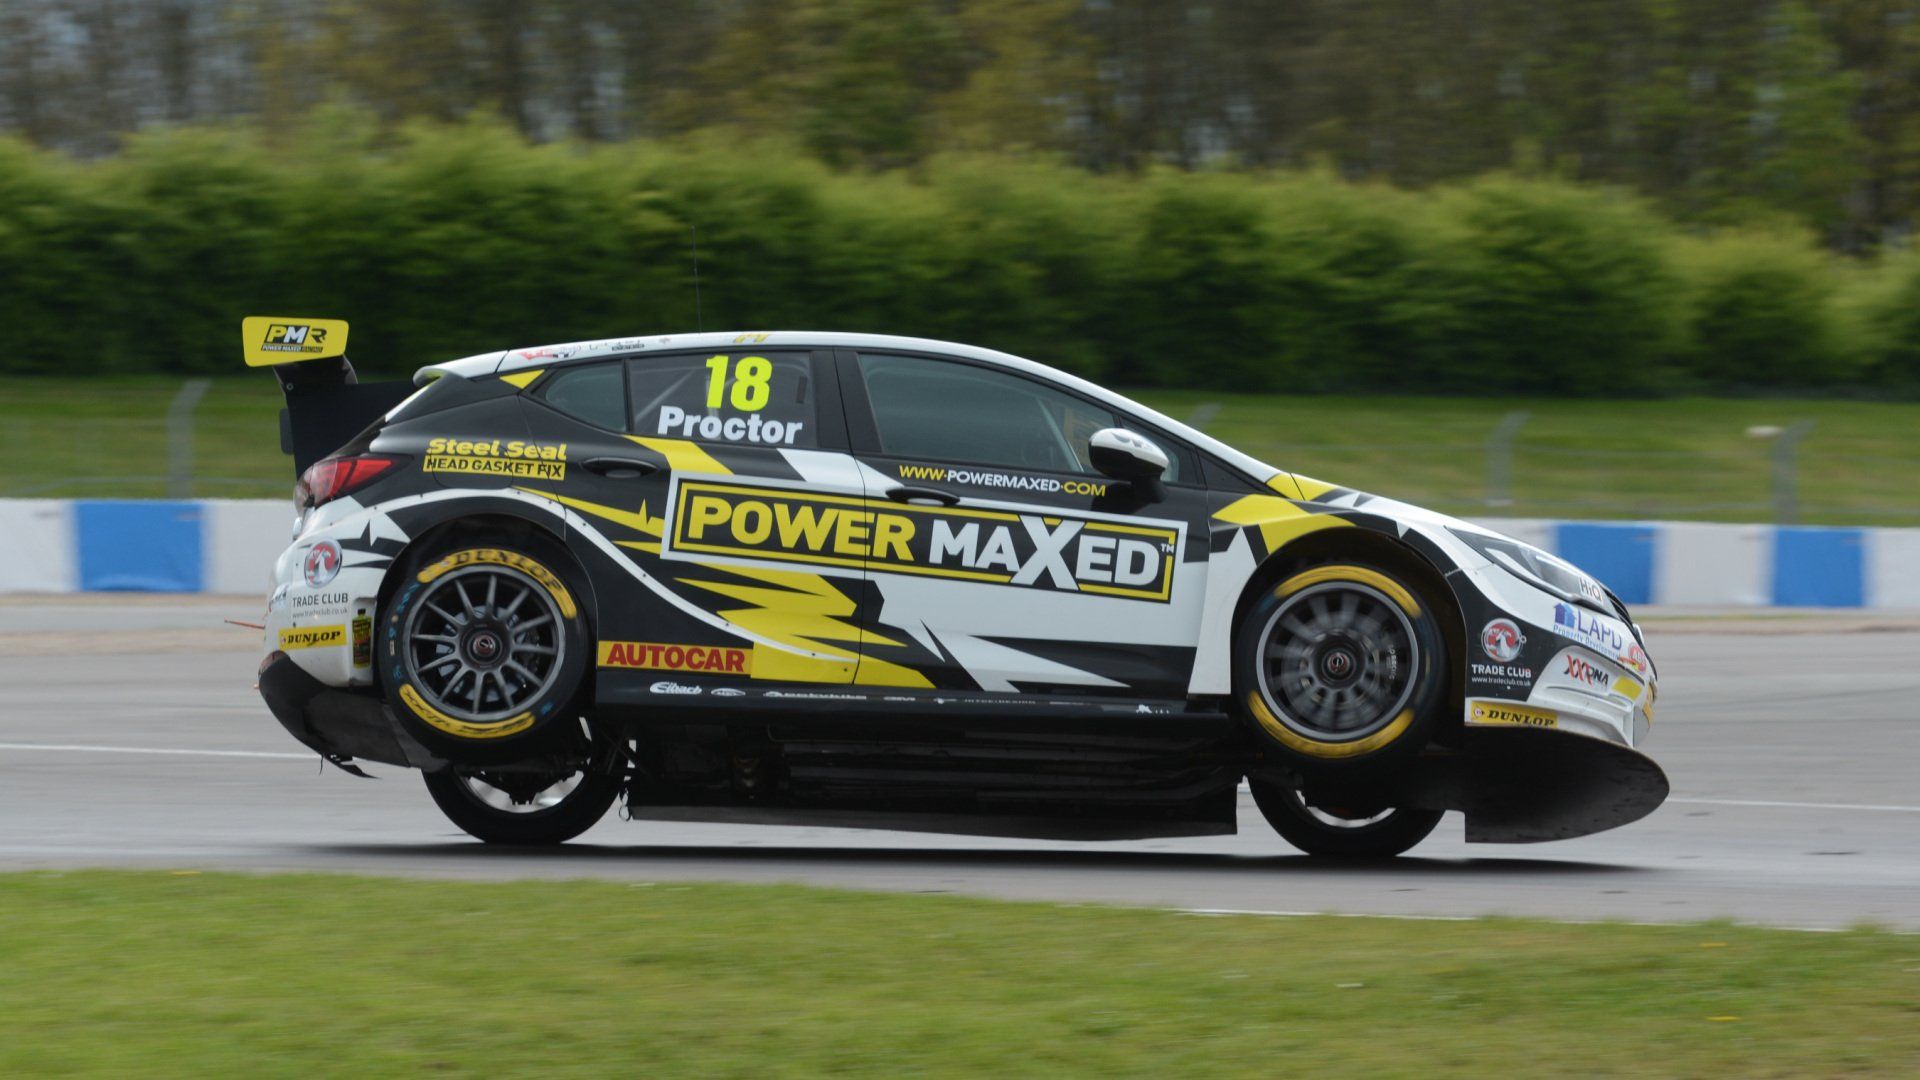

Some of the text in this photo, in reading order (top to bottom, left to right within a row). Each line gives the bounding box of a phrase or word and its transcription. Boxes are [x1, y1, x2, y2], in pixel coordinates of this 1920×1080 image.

[264, 324, 328, 344] PMR
[706, 355, 772, 412] 18
[657, 405, 803, 444] Proctor
[427, 438, 567, 460] Steel Seal
[427, 458, 562, 477] HEAD GASKET FIX
[688, 496, 916, 561] POWER
[293, 595, 319, 608] TRADE
[322, 593, 349, 604] CLUB
[288, 631, 341, 647] DUNLOP
[606, 643, 745, 673] AUTOCAR
[1471, 664, 1532, 678] TRADE CLUB
[650, 681, 702, 695] Eibach
[1471, 677, 1532, 687] www.tradeclub.co.uk
[1488, 710, 1554, 726] DUNLOP
